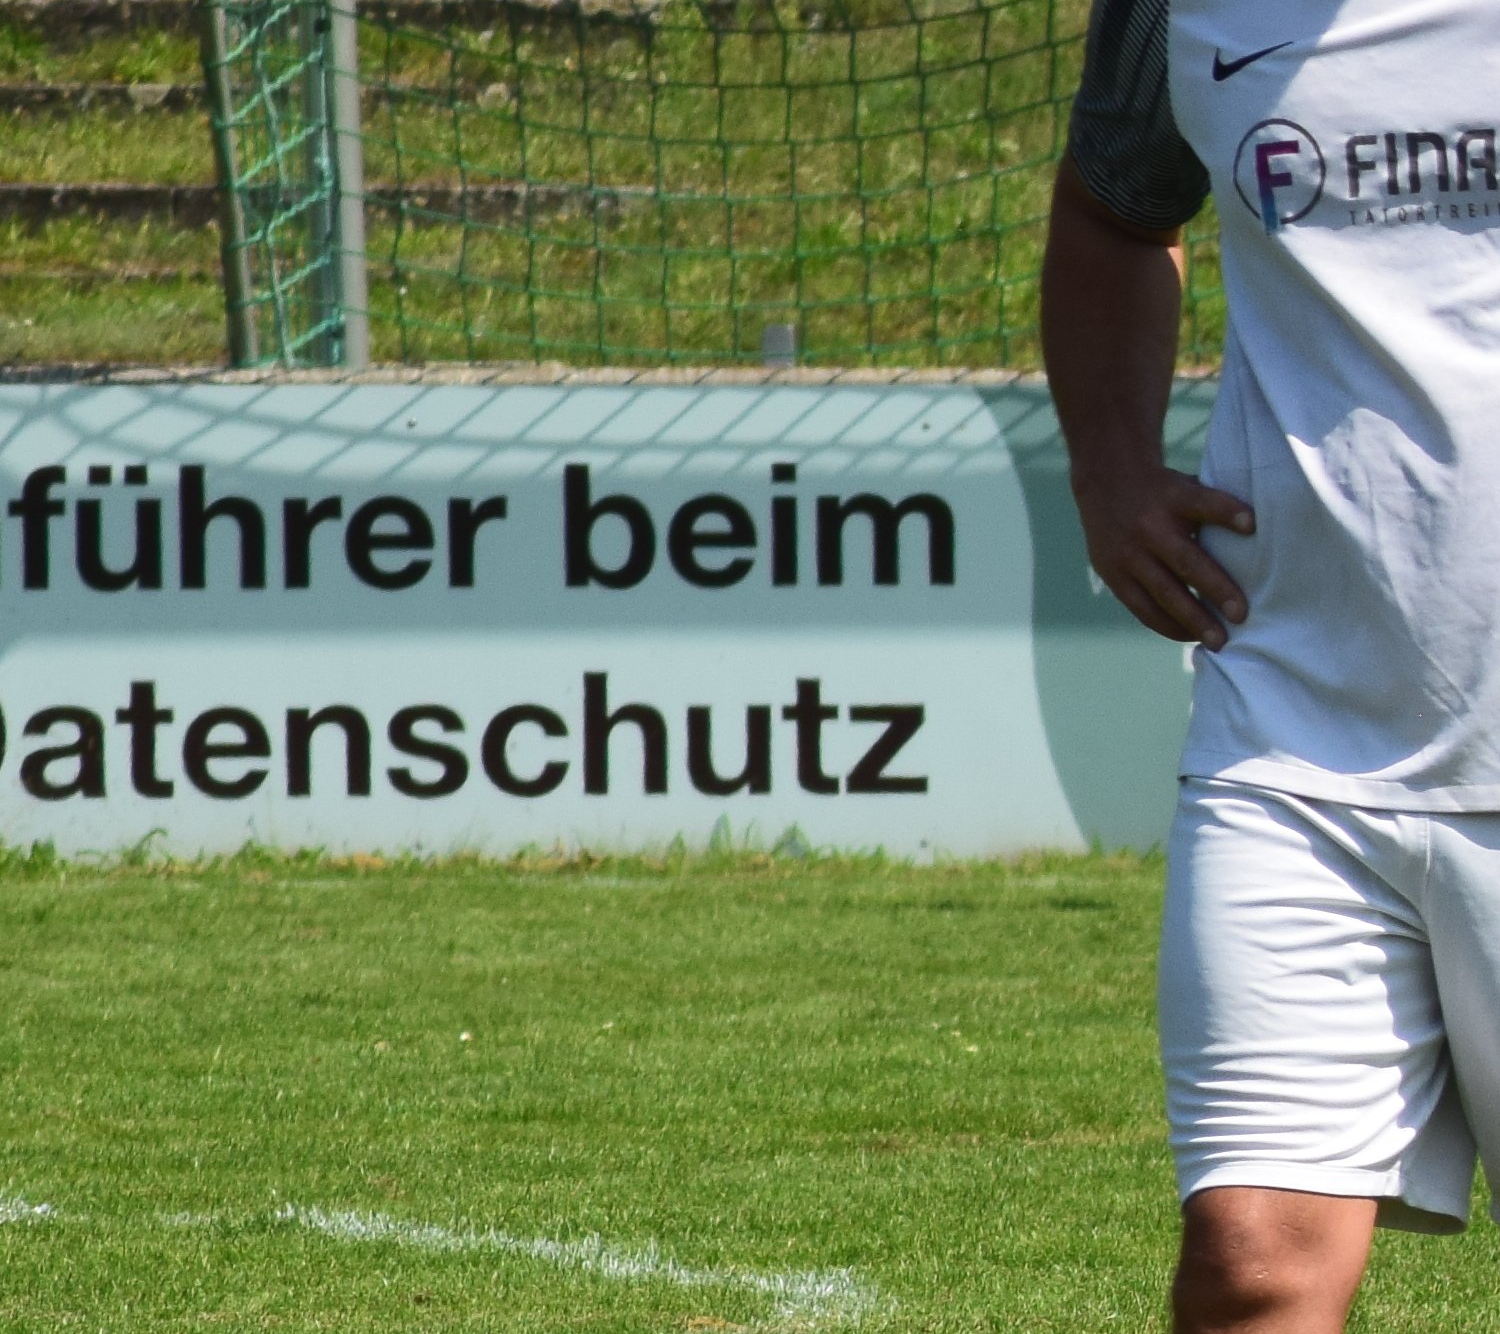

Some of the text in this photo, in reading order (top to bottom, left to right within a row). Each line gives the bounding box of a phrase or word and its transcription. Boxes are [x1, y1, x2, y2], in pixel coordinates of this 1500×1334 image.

[0, 462, 955, 591] führer beim
[0, 670, 928, 800] atenschutz
